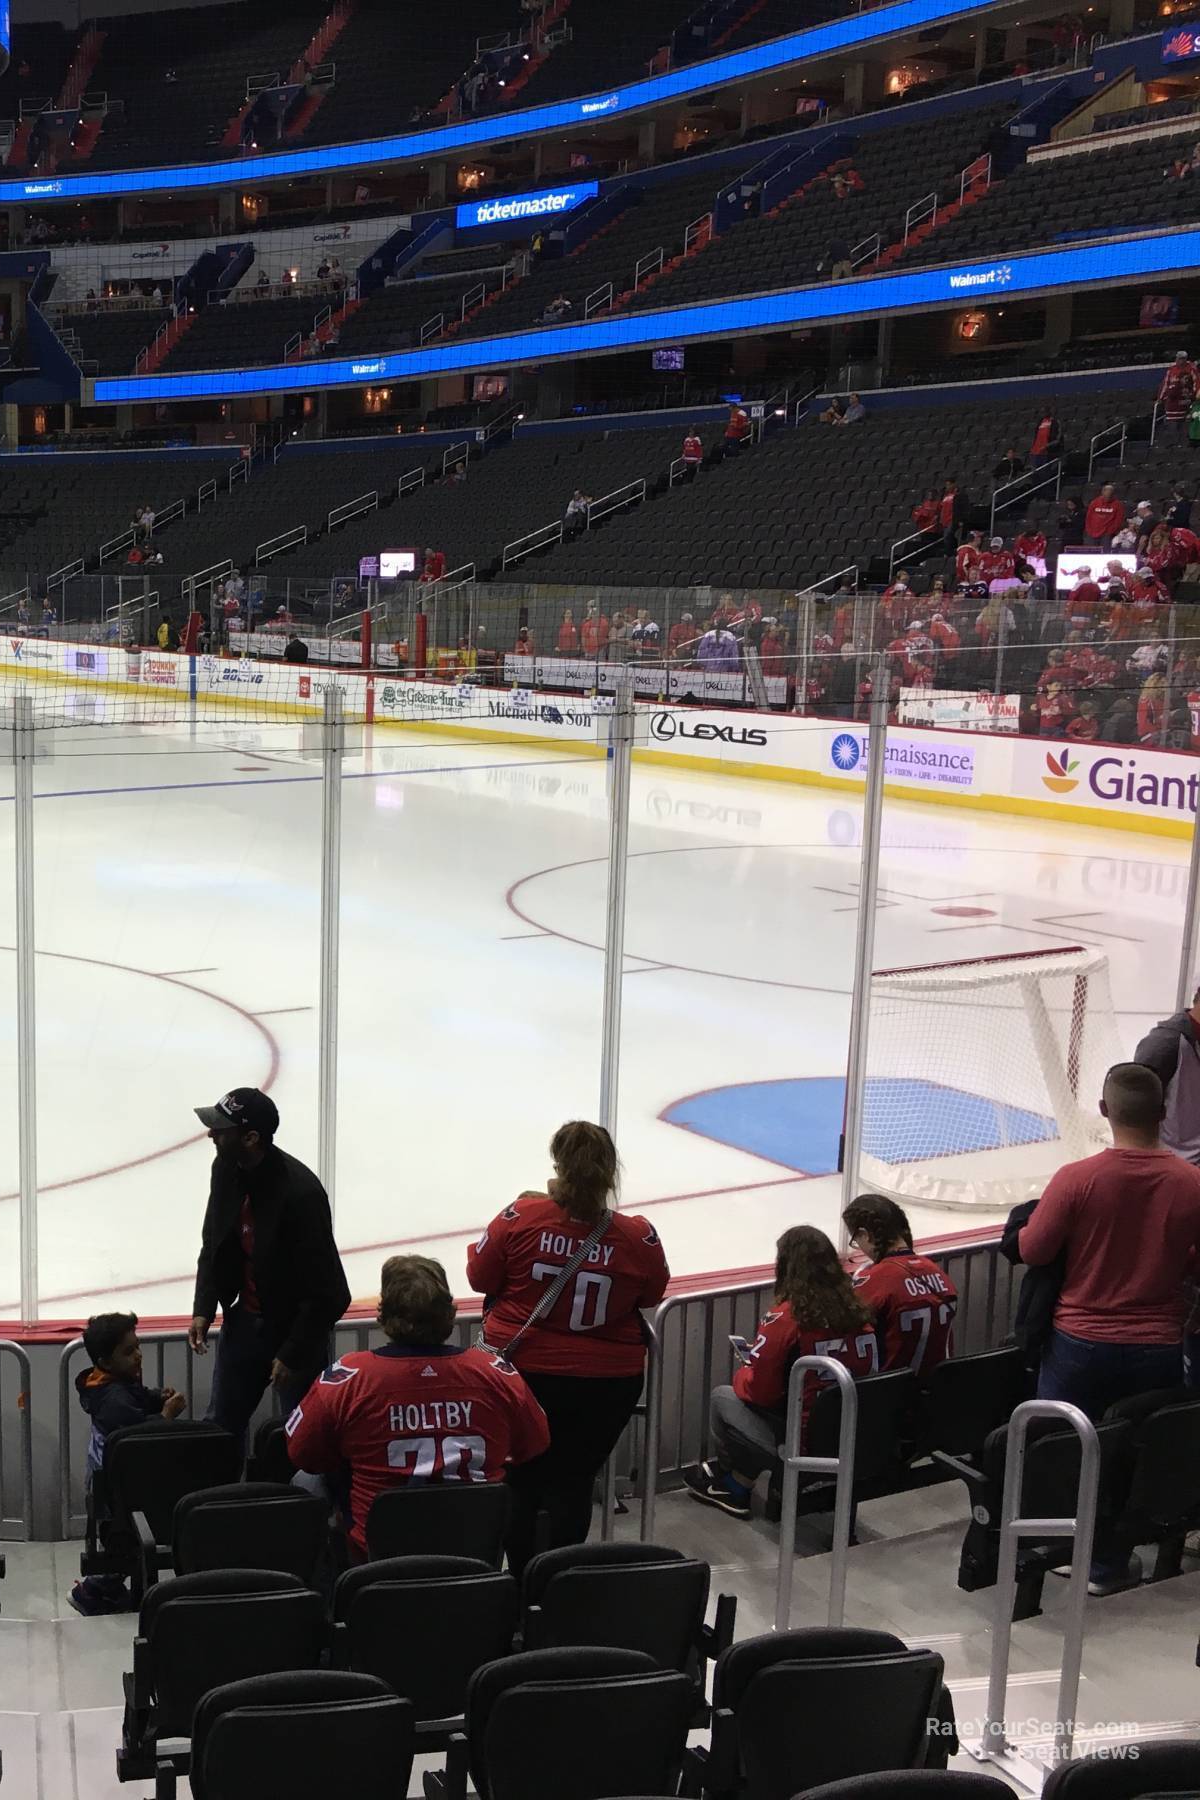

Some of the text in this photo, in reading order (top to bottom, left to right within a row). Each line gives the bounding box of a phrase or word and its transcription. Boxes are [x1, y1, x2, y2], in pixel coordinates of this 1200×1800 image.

[582, 100, 609, 113] Walmart
[25, 184, 53, 193] Walmart
[477, 194, 570, 223] ticketmaster
[950, 270, 995, 288] Walmart
[353, 364, 378, 374] Walmart
[407, 688, 437, 705] Greene
[566, 709, 592, 728] Son
[680, 721, 767, 746] LEXUS
[1089, 757, 1200, 813] Giant
[532, 1262, 613, 1332] 70
[905, 1272, 949, 1297] OSHIE
[389, 1401, 473, 1432] HOLTBY
[387, 1435, 488, 1486] 70
